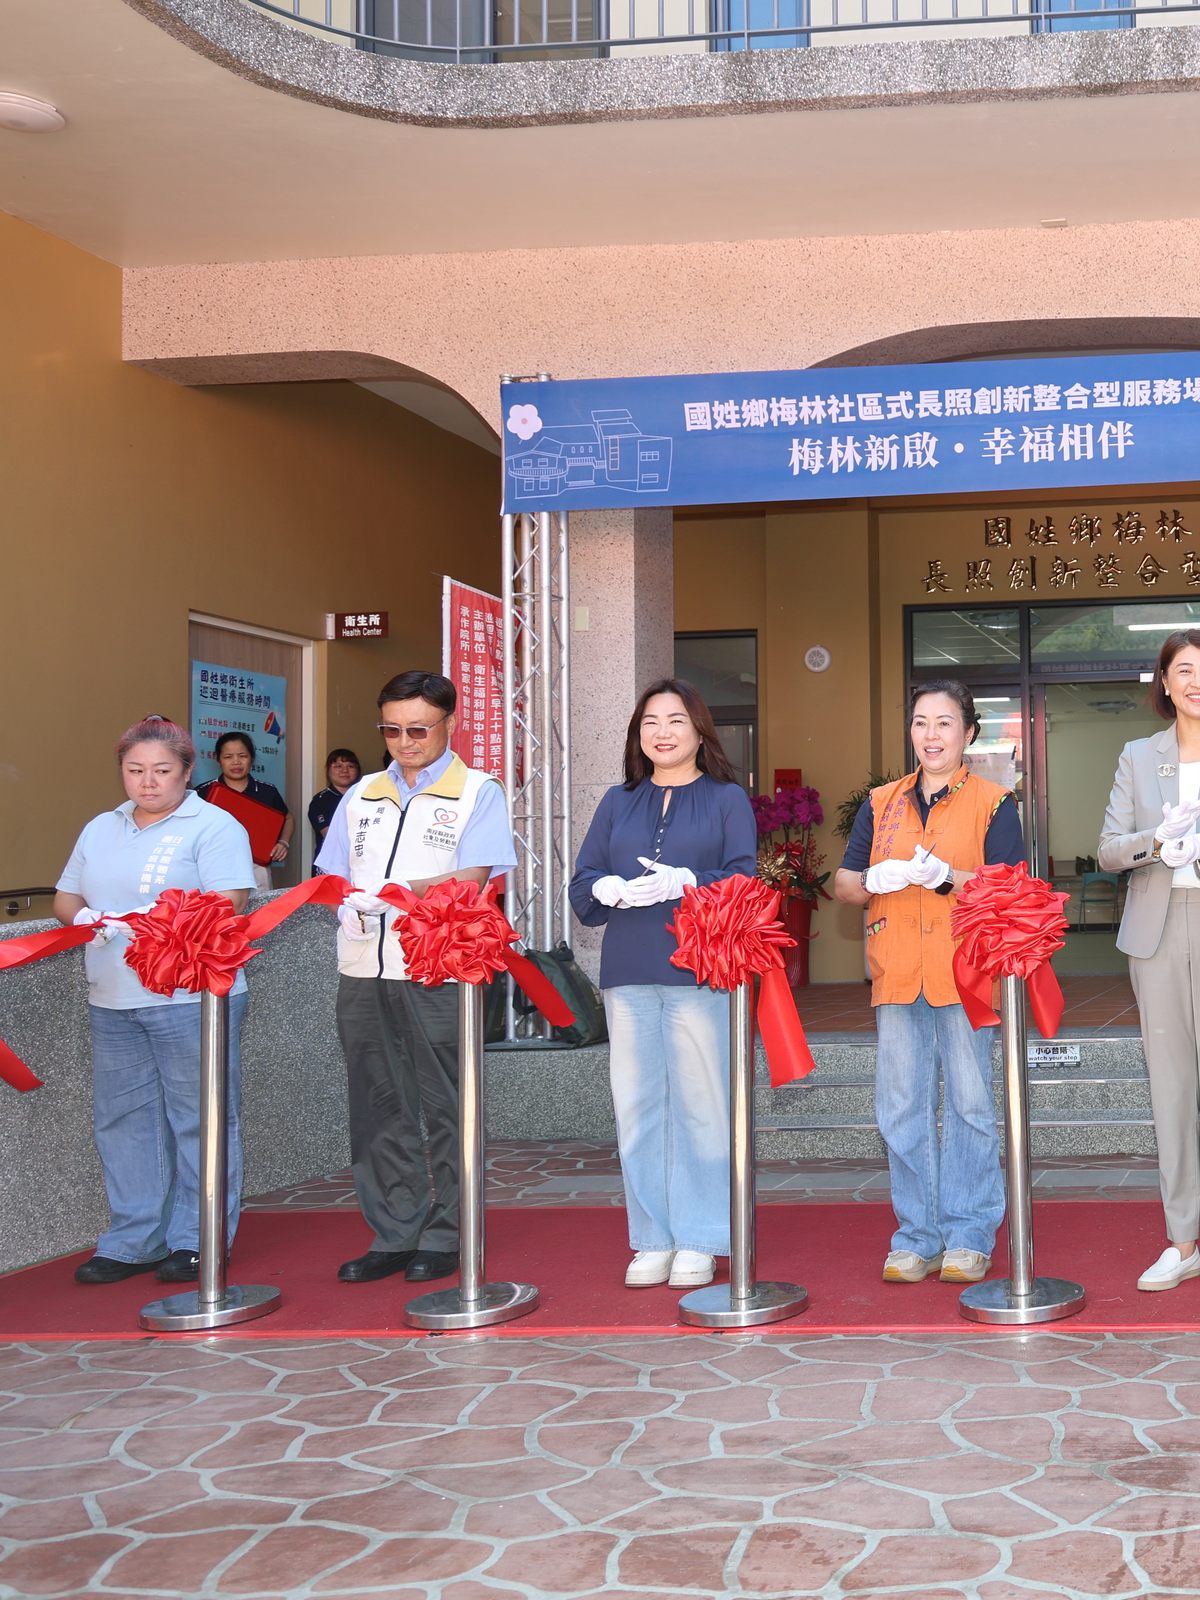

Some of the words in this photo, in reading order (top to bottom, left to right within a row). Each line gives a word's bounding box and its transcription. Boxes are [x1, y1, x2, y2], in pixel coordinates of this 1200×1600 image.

[344, 614, 381, 627] 衛生所
[342, 628, 361, 637] Health
[362, 628, 382, 636] Center
[201, 669, 254, 691] 國姓鄉衛生所
[473, 610, 486, 772] 主辦單位：衛生福利部中央健康
